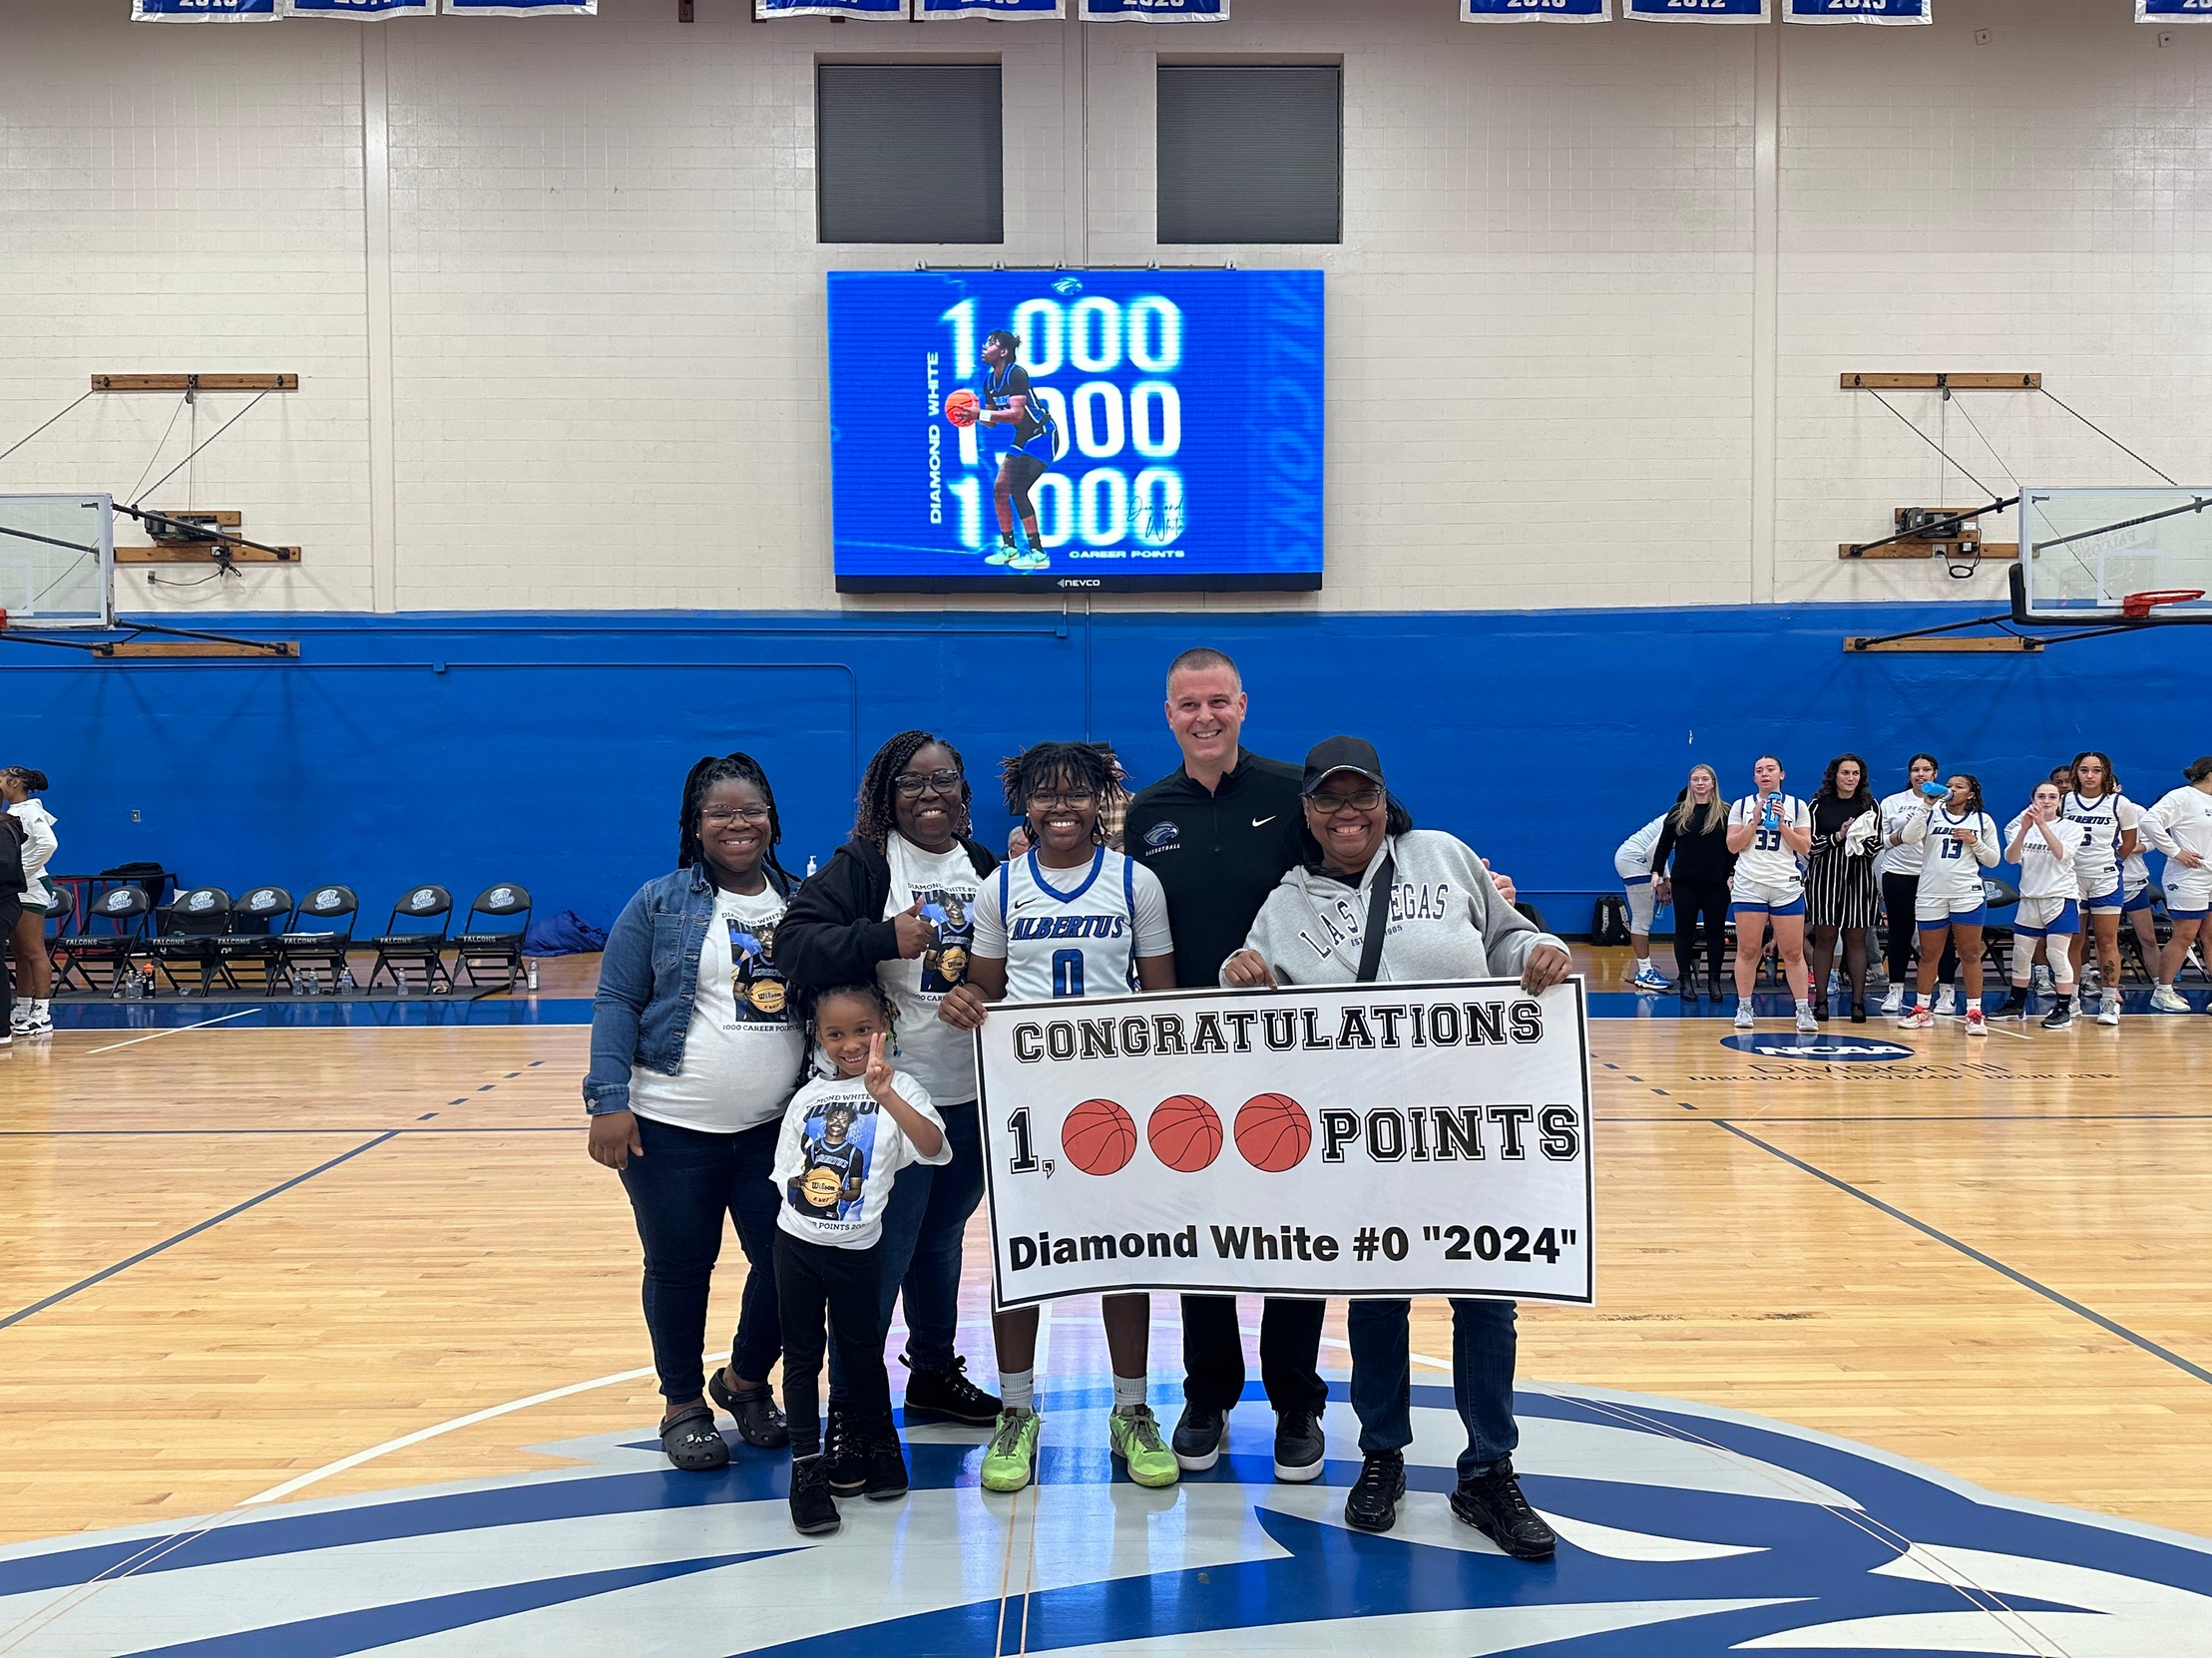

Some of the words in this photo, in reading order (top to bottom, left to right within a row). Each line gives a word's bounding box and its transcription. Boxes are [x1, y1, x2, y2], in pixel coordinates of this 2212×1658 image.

[927, 351, 940, 417] WHITE
[928, 424, 942, 525] DIAMOND
[1130, 550, 1185, 559] POINTS
[1755, 830, 1782, 852] 33
[1941, 838, 1964, 860] 13
[1010, 915, 1125, 941] ALBERTUS
[1299, 900, 1360, 961] LAS
[1371, 882, 1450, 923] EGAS
[153, 938, 186, 947] FALCONS
[1052, 949, 1086, 999] 0
[1013, 1000, 1545, 1064] CONGRATULATIONS
[1755, 1045, 1916, 1055] NCAA
[1747, 1063, 1961, 1073] Division
[1319, 1104, 1580, 1163] POINTS
[818, 1222, 850, 1231] POINTS
[1009, 1225, 1197, 1272] Diamond
[1209, 1225, 1340, 1262] White
[1352, 1226, 1410, 1262] #0
[1422, 1225, 1577, 1265] "2024"
